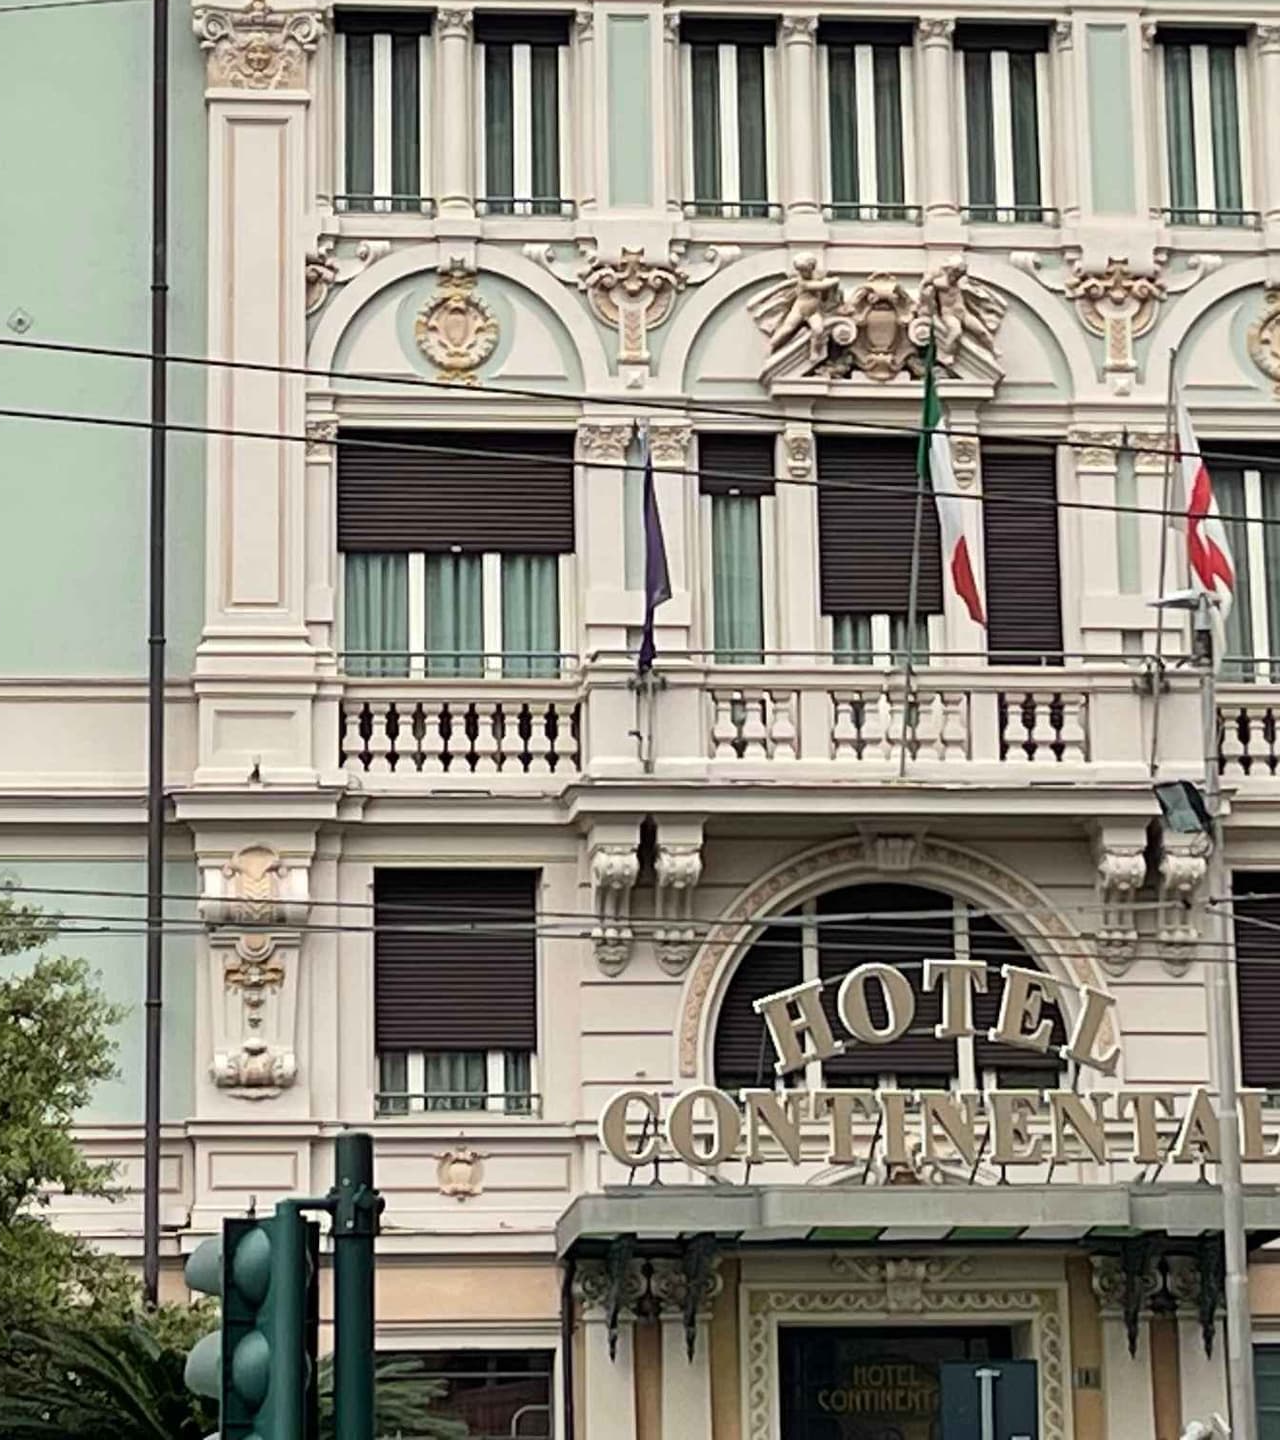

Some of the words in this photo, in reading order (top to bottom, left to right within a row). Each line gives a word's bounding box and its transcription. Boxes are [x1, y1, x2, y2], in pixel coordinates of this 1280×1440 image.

[753, 959, 1121, 1077] HOTEL
[853, 1363, 919, 1386] HOTEL
[817, 1388, 935, 1412] CONTINENT
